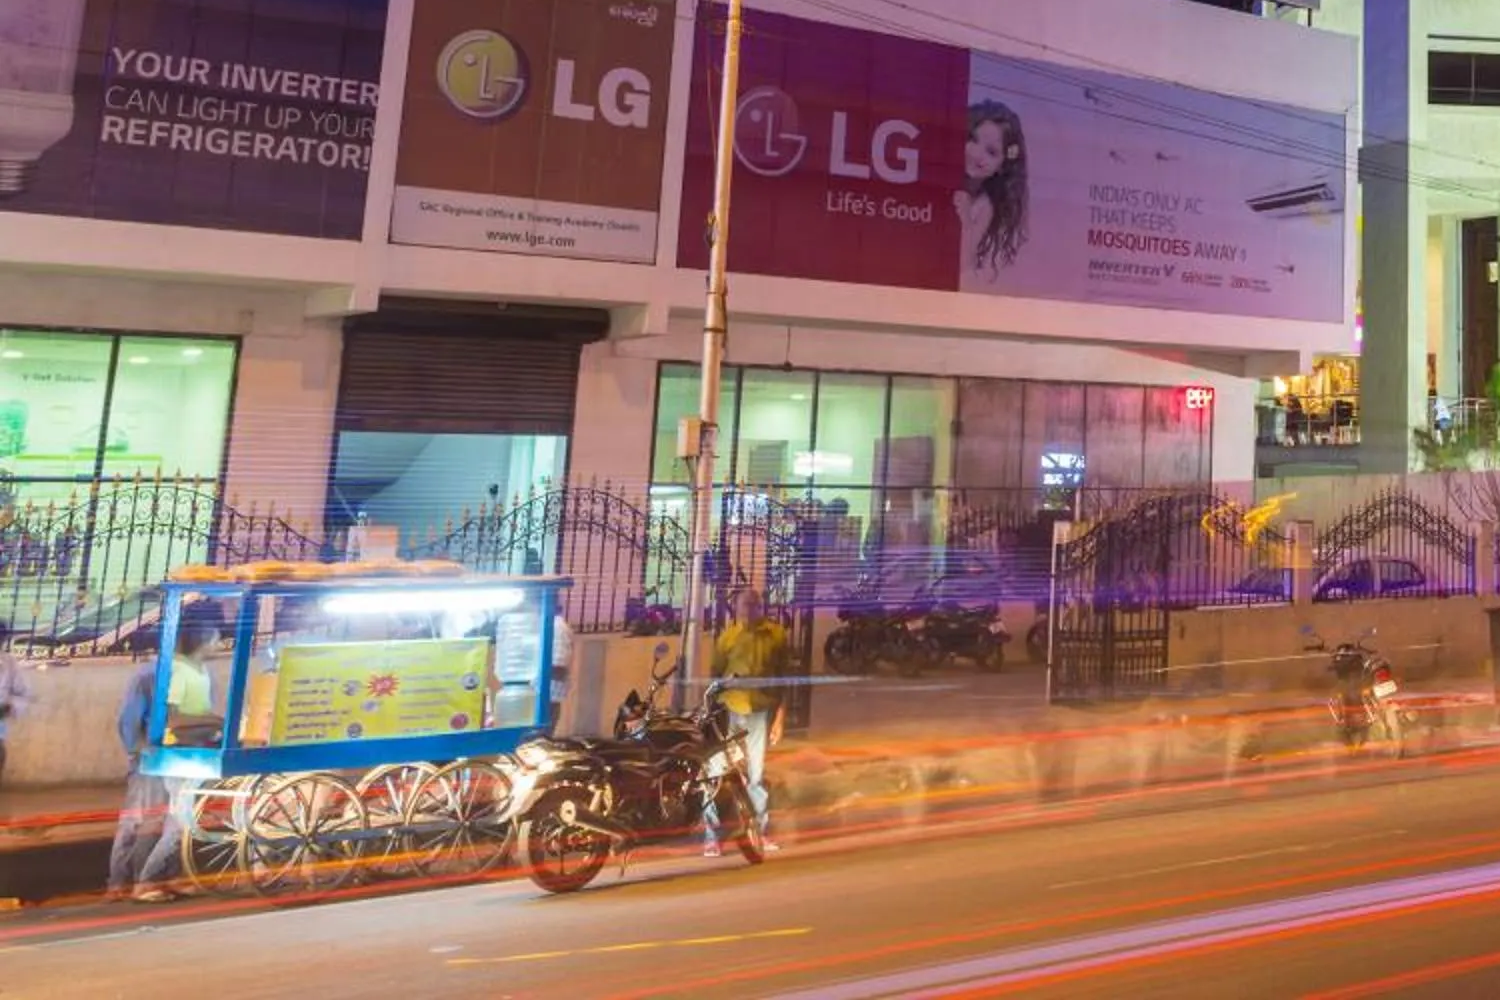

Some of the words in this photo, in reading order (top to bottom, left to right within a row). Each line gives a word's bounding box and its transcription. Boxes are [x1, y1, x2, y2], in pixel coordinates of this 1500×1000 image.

[112, 47, 210, 85] YOUR
[221, 62, 380, 106] INVERTER
[552, 58, 651, 128] LG
[104, 85, 168, 115] CAN
[176, 94, 258, 126] LIGHT
[263, 105, 302, 130] UP
[309, 111, 376, 138] YOUR
[101, 115, 371, 170] REFRIGERATOR!
[829, 111, 921, 184] LG
[443, 205, 483, 218] Regional
[486, 207, 515, 220] Office
[826, 190, 876, 217] Life's
[883, 197, 932, 223] Good
[1088, 206, 1126, 225] THAT
[1131, 212, 1176, 233] KEEPS
[1143, 191, 1180, 213] ONLY
[1184, 197, 1204, 215] AC
[486, 229, 576, 248] www.lge.com
[1087, 229, 1191, 258] MOSQUITOES
[1194, 242, 1237, 262] AWAY
